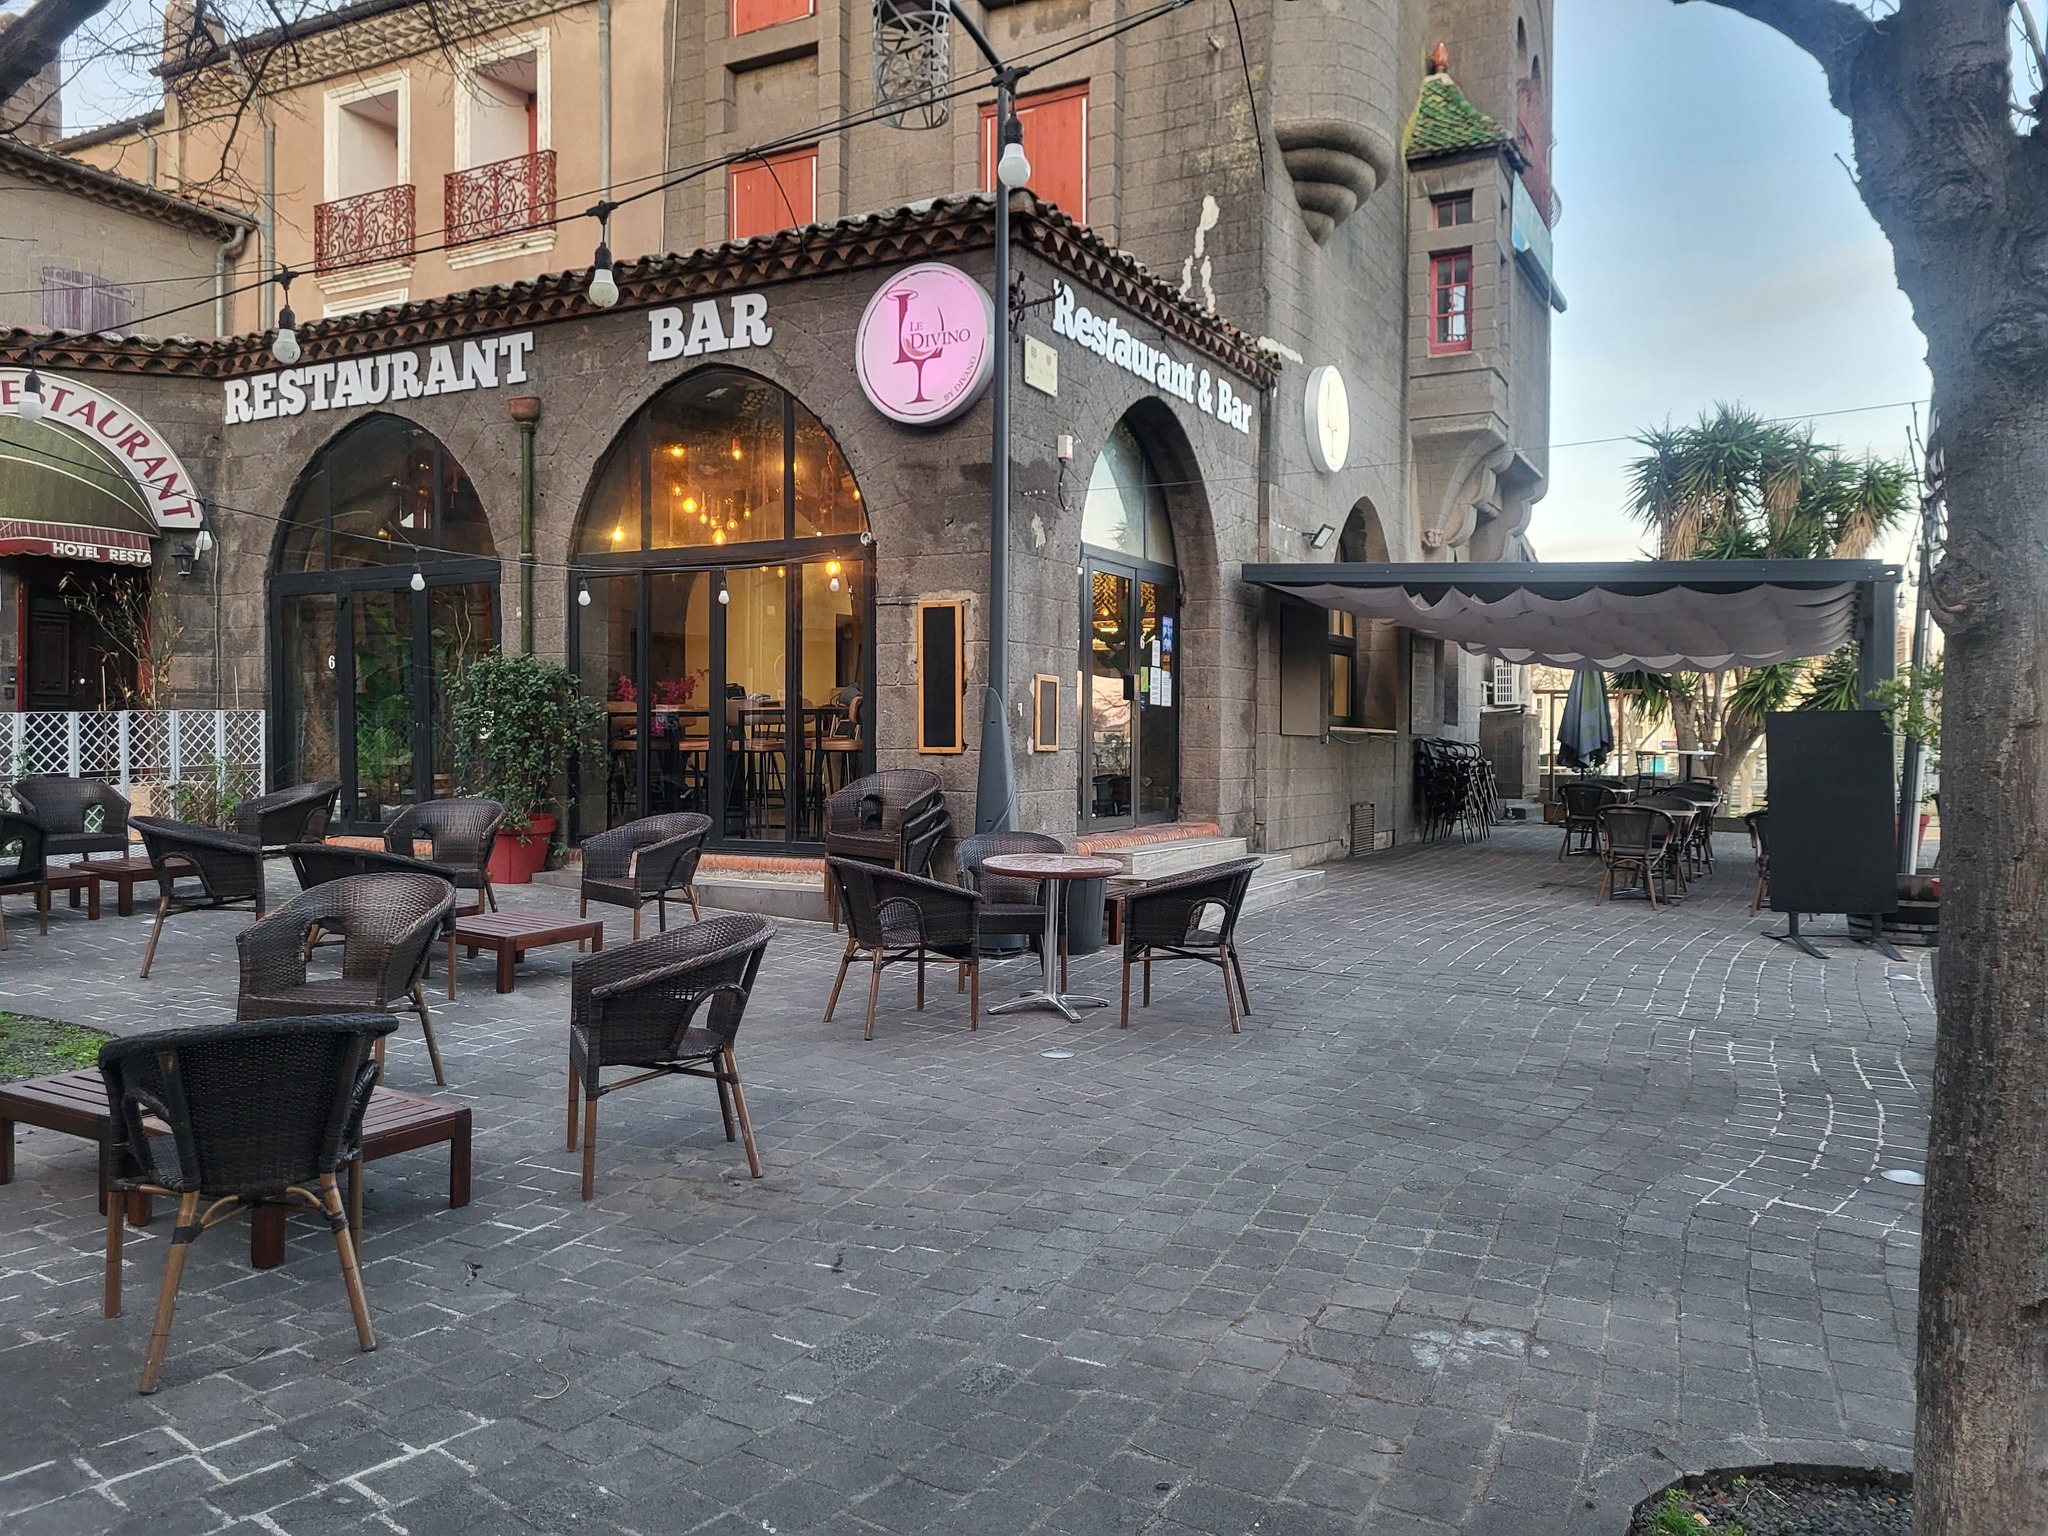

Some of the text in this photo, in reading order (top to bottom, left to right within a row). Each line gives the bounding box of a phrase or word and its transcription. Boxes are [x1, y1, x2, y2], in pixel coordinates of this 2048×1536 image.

[647, 293, 773, 362] BAR
[910, 321, 923, 332] LE
[910, 328, 971, 349] DIVINO
[1053, 278, 1195, 404] Restaurant
[1197, 368, 1213, 415] &
[1217, 378, 1252, 434] Bar
[224, 331, 534, 425] RESTAURANT
[943, 356, 976, 402] BY DIVANO
[52, 542, 152, 565] HOTEL RESTA
[328, 655, 336, 670] 6
